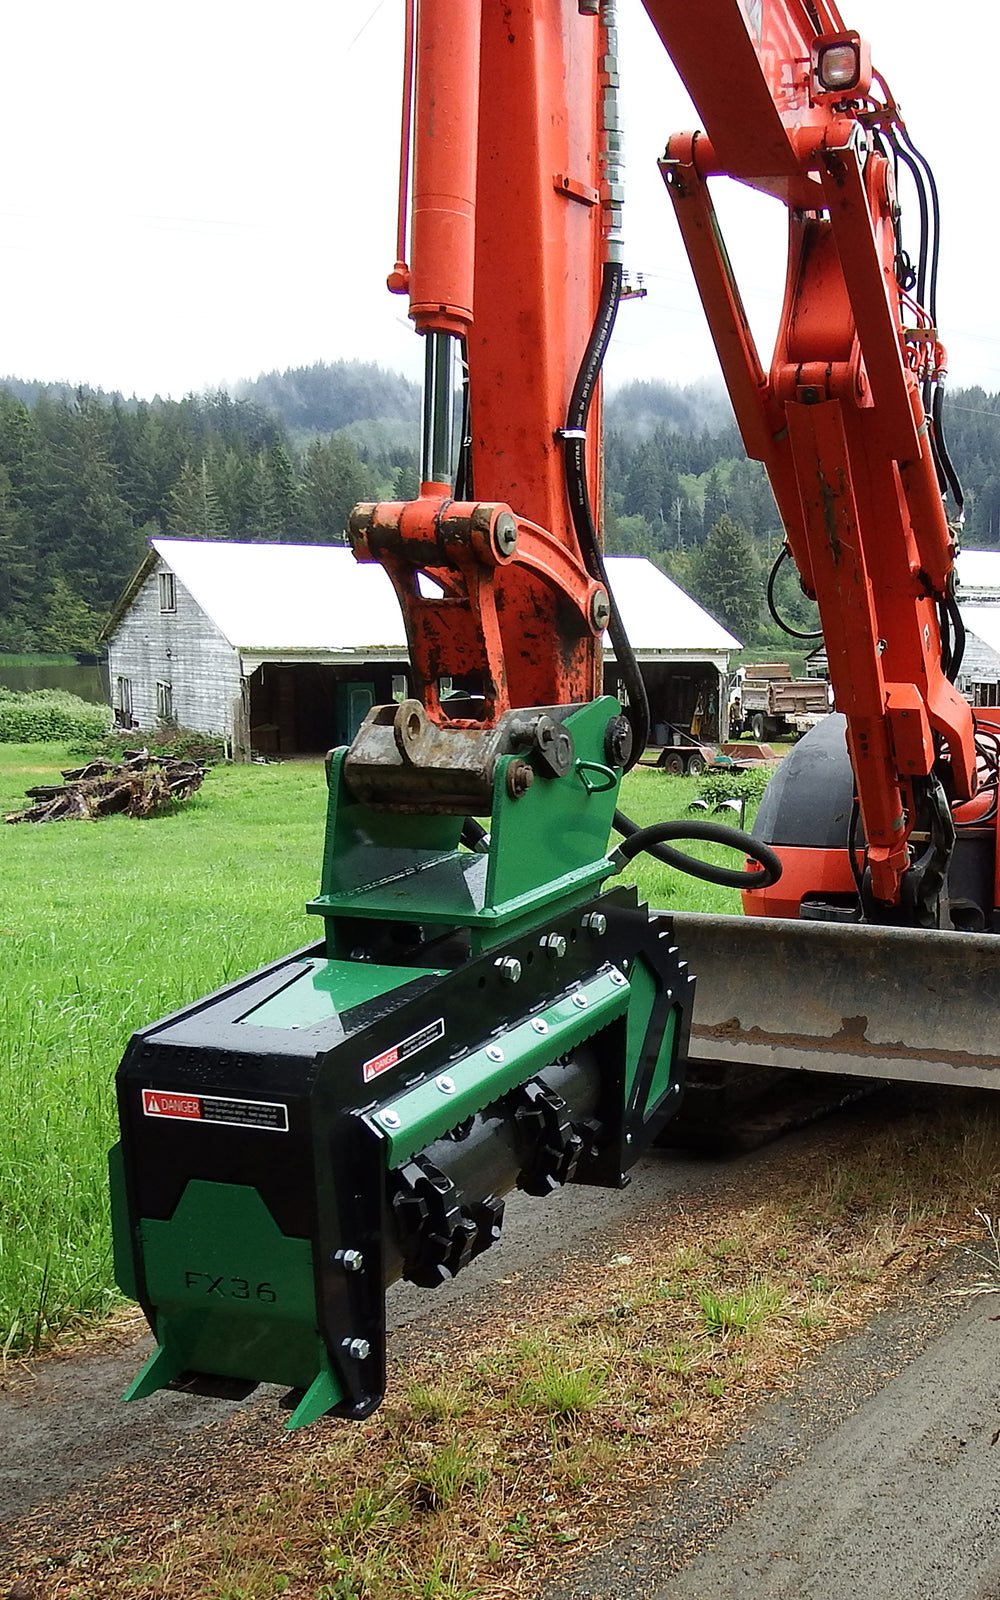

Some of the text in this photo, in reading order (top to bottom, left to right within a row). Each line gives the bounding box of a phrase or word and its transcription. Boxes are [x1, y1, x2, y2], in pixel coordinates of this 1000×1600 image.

[374, 1051, 399, 1072] DANGER
[160, 1098, 201, 1114] DANGER
[185, 1271, 277, 1303] FX36
